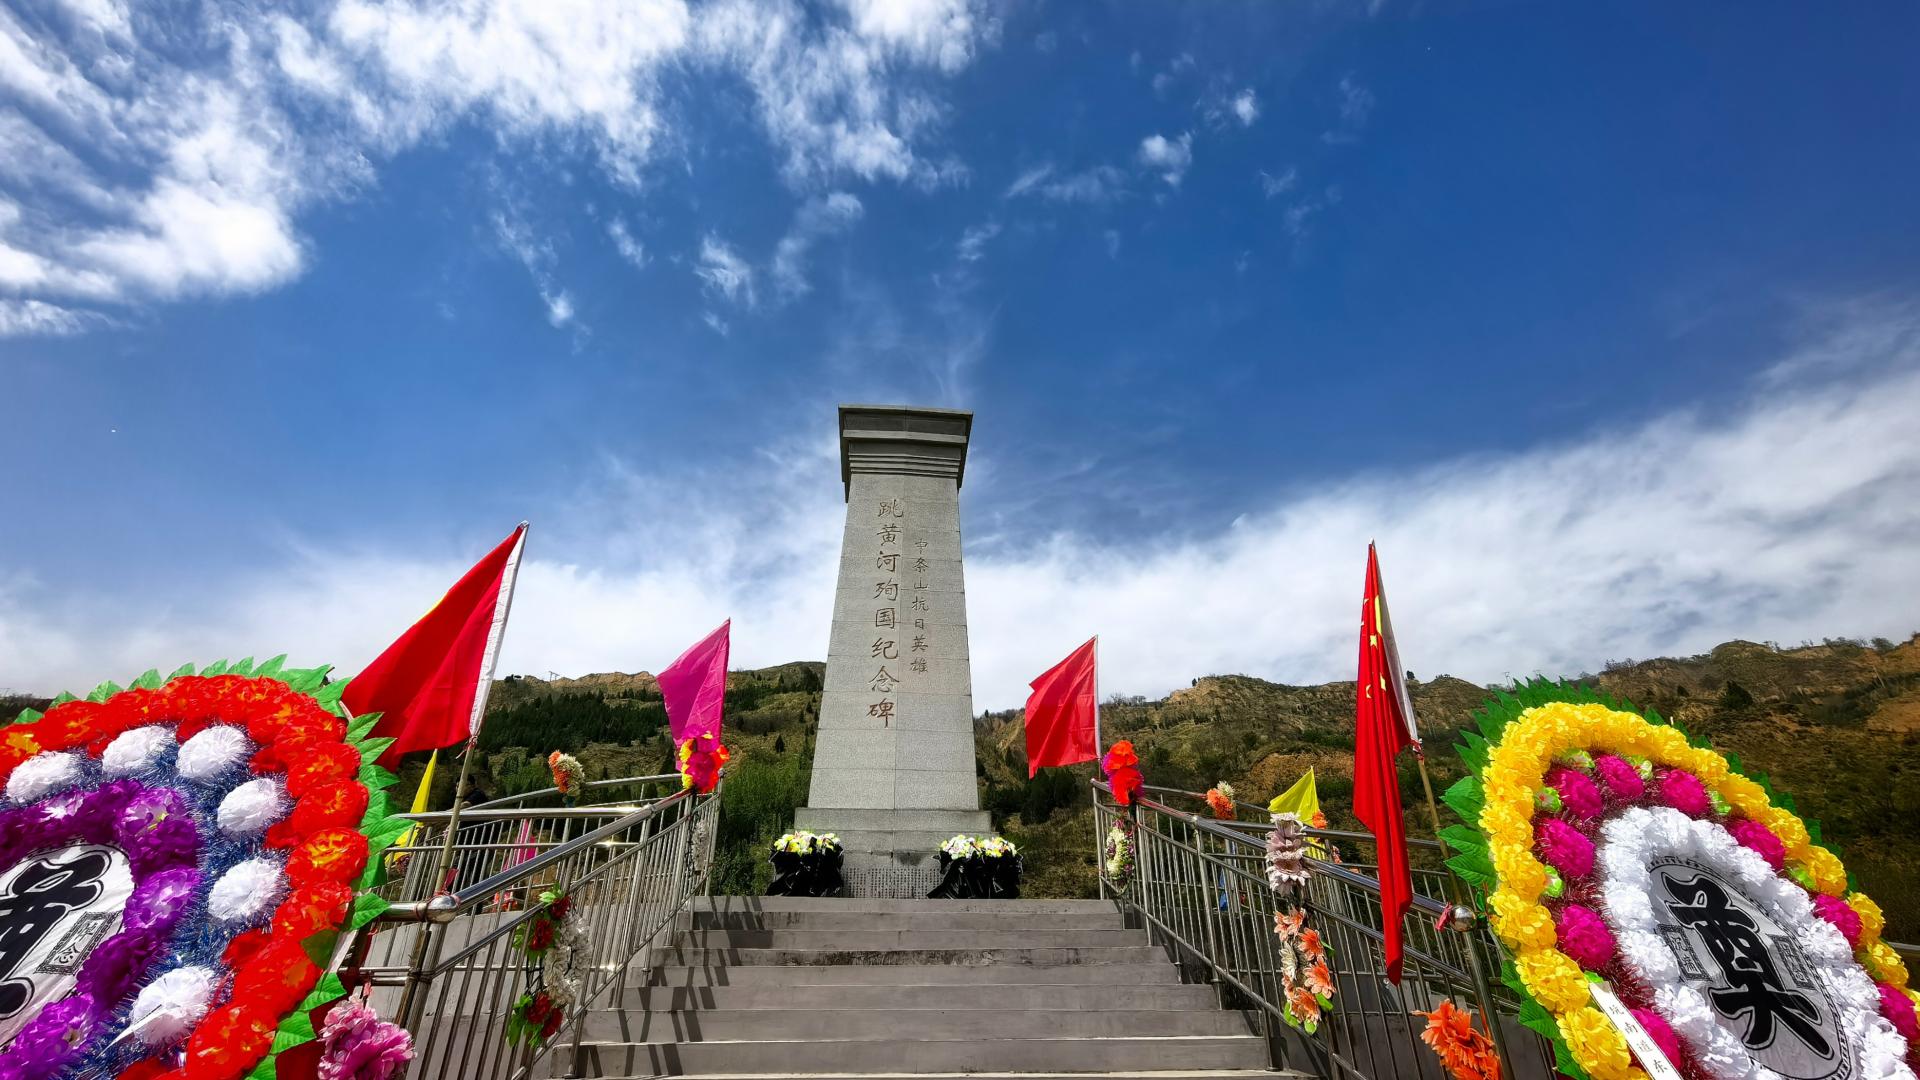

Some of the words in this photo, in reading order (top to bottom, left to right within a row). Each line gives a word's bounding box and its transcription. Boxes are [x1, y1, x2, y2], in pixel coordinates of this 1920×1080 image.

[866, 498, 904, 728] 跳黄河殉国纪念碑
[910, 538, 929, 673] 中条山抗日英雄
[1660, 871, 1834, 1060] 奠
